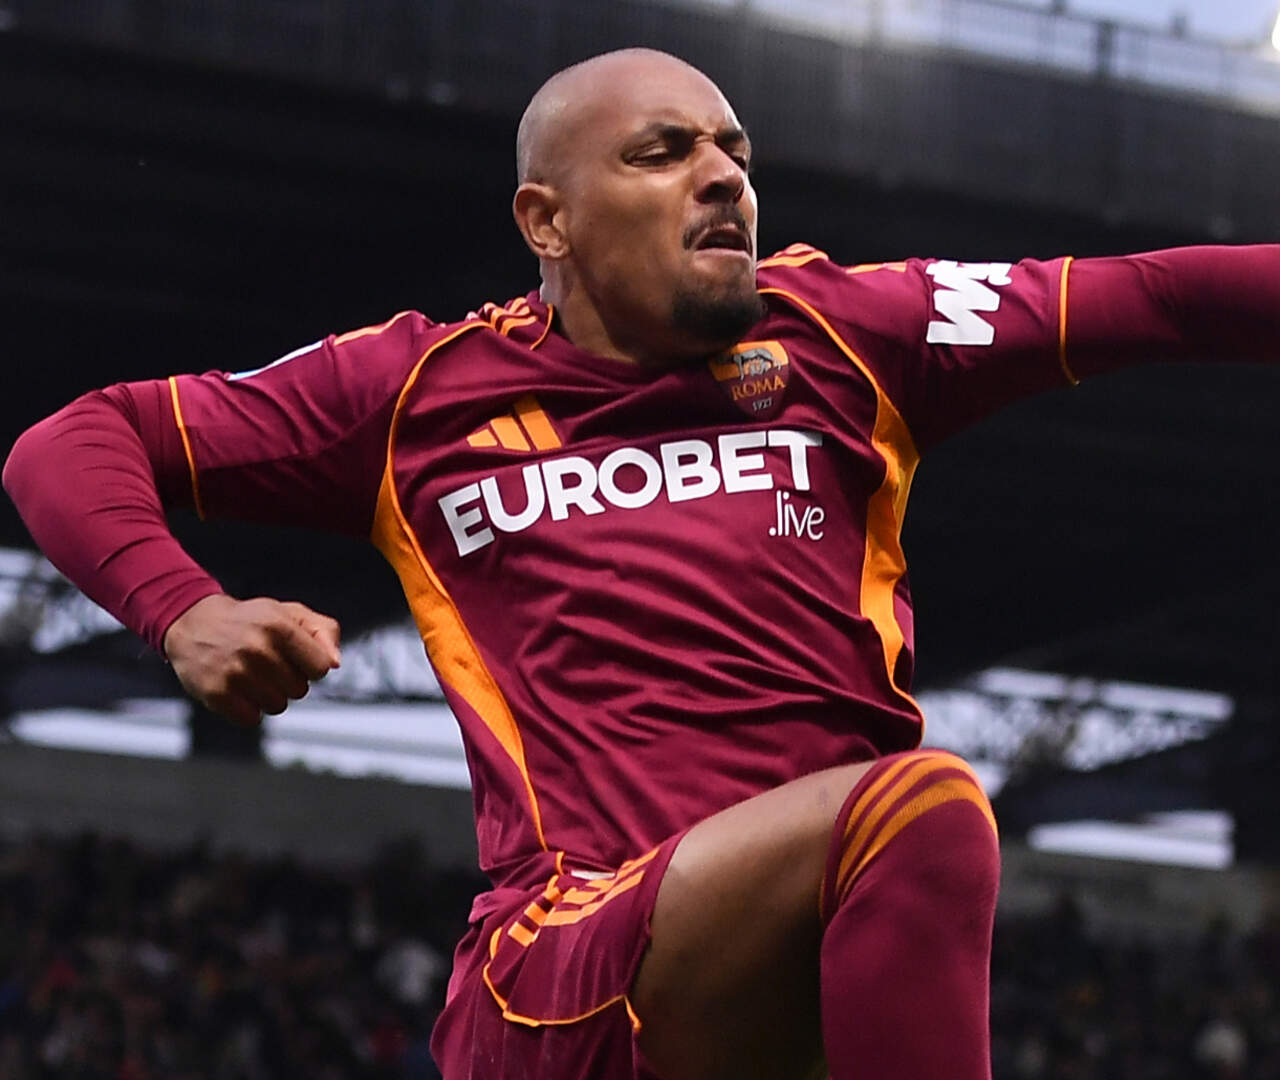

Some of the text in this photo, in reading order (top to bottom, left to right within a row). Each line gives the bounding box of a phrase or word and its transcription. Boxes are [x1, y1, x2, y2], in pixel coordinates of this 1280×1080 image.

[732, 375, 786, 400] ROMA
[438, 430, 823, 557] EUROBET
[768, 490, 825, 540] .live
